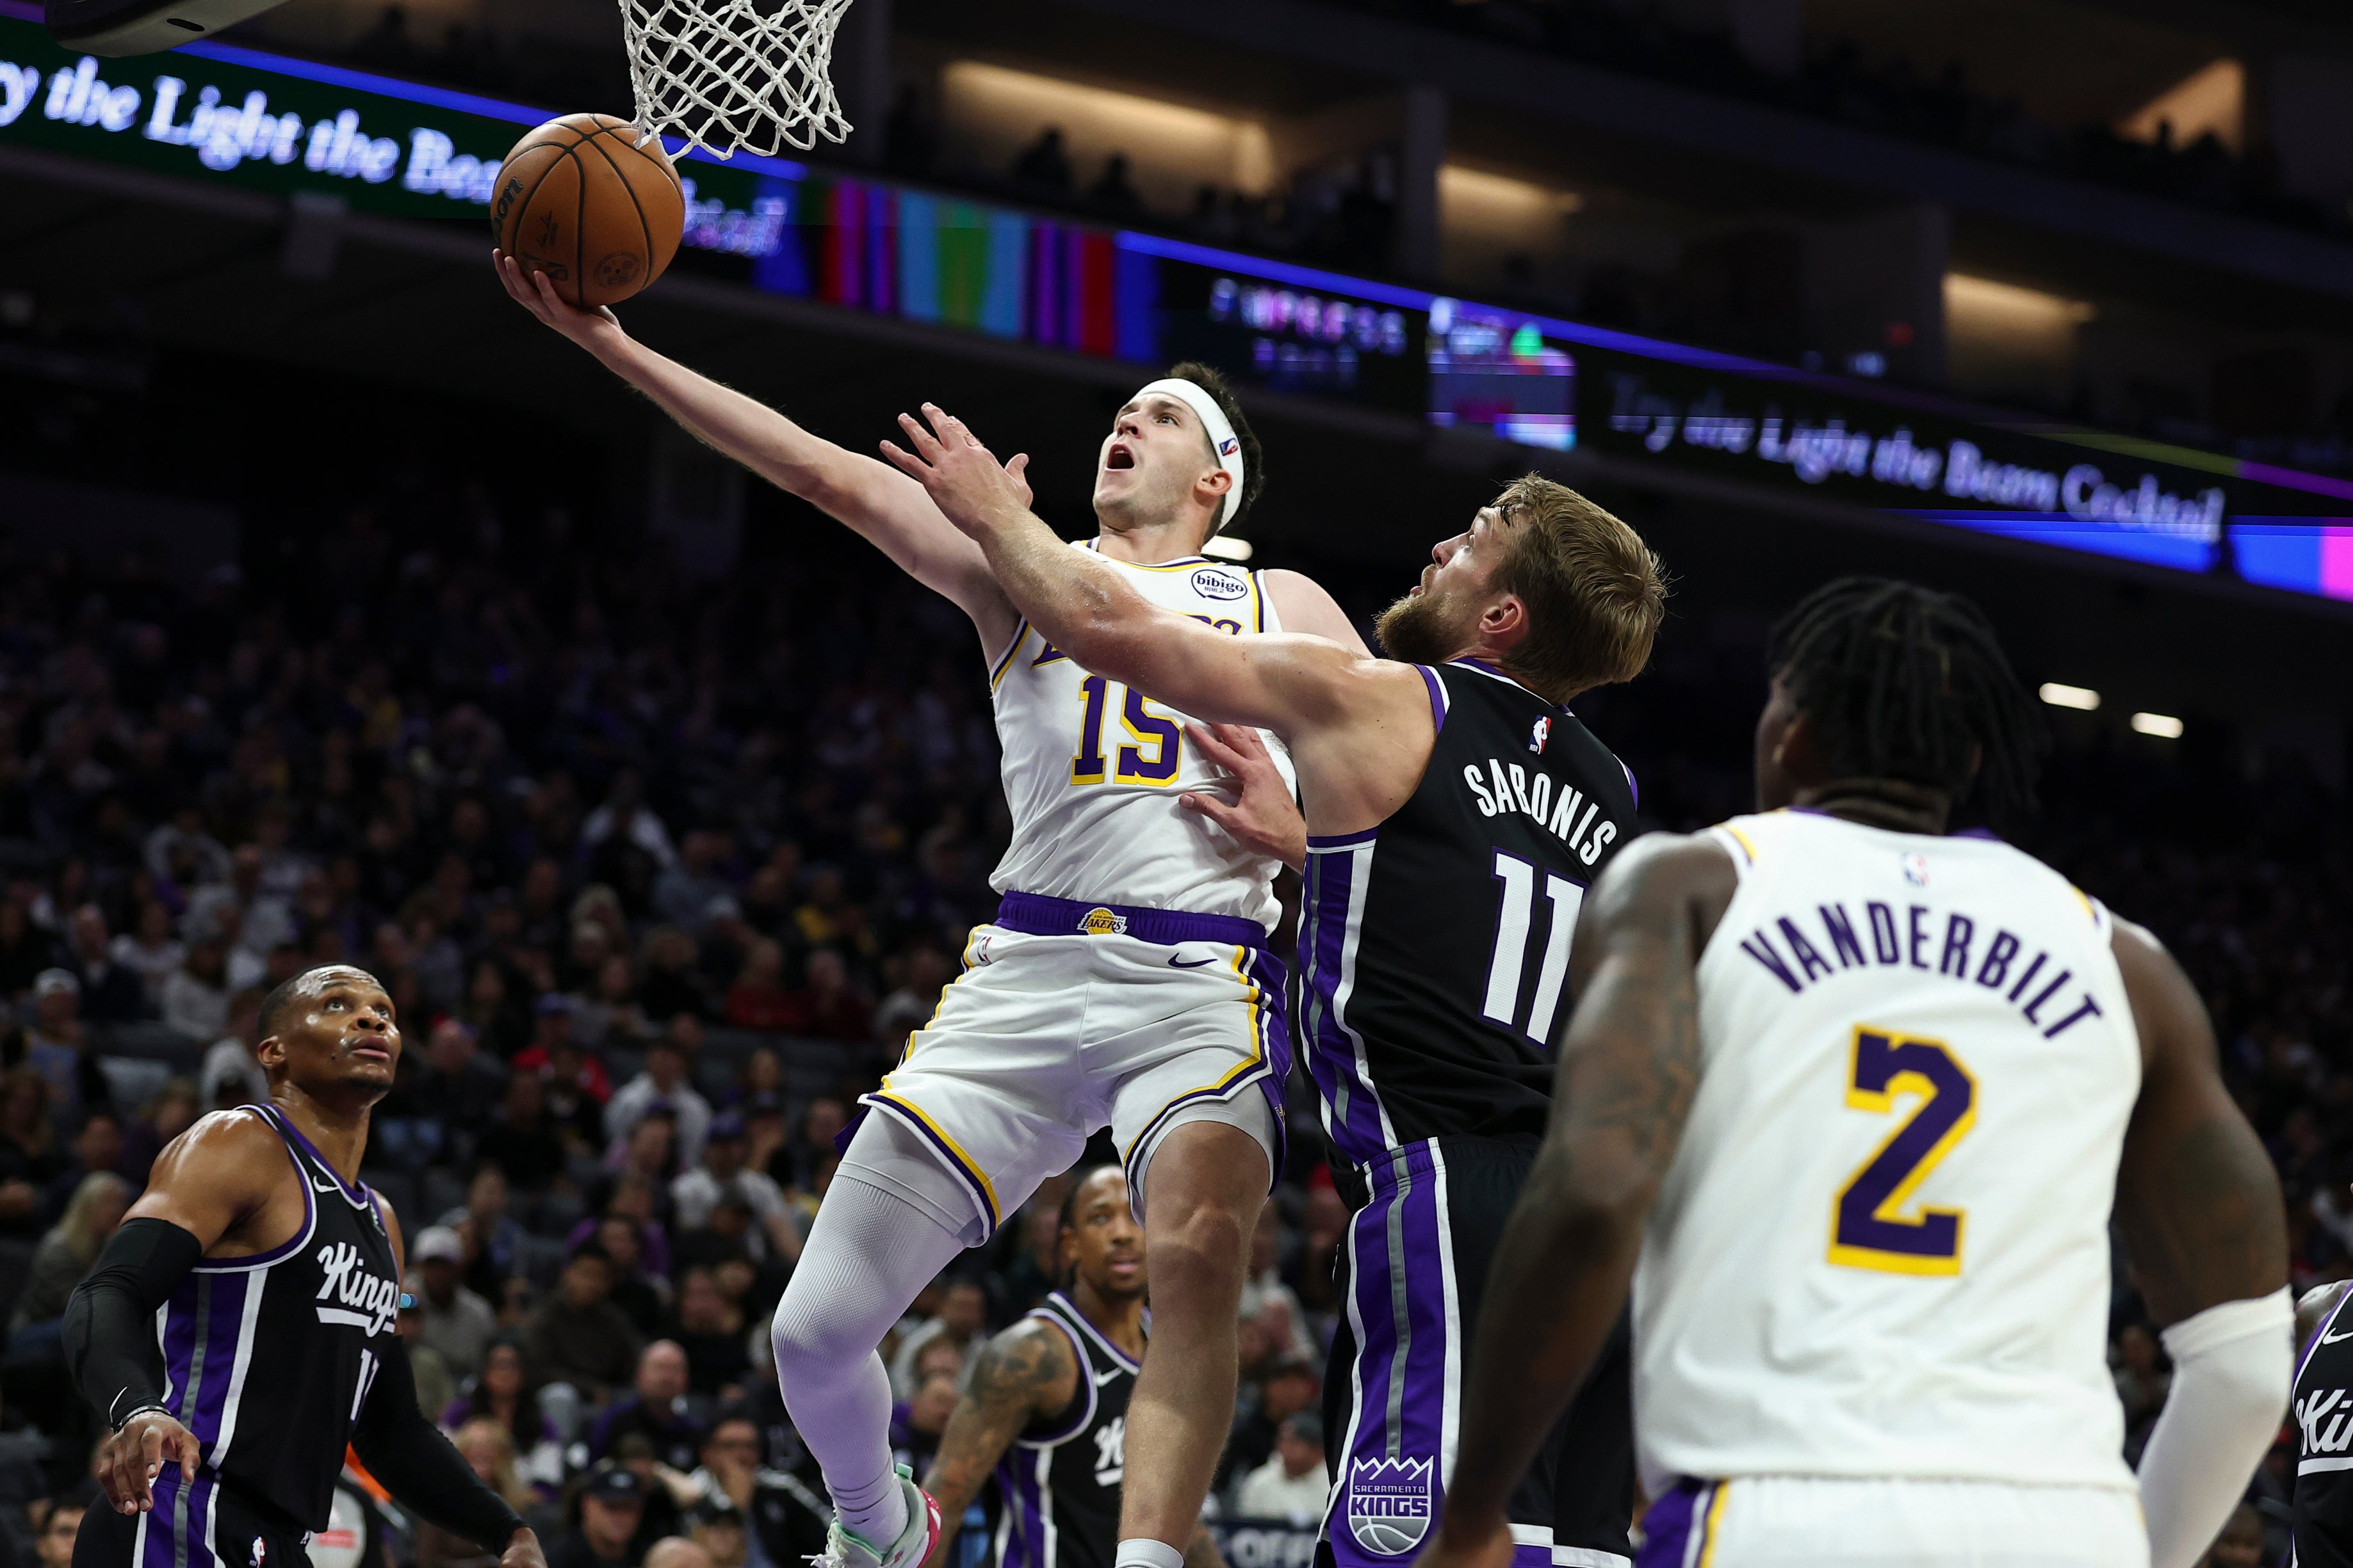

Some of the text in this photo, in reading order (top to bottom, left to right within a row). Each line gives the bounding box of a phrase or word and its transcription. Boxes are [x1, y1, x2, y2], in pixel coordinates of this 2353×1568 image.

[45, 55, 142, 132] the
[143, 76, 304, 171] Light
[305, 108, 400, 184] the
[402, 127, 505, 204] Bea
[1683, 389, 1755, 454] the
[1757, 405, 1871, 484] Light
[1871, 426, 1944, 490] the
[1943, 439, 2059, 512] Beam
[2061, 464, 2226, 543] Cocktail
[1196, 574, 1244, 592] bibigo
[1071, 674, 1184, 787] 15
[1463, 758, 1617, 866] SABONIS
[1080, 914, 1125, 934] LAKERS
[1480, 848, 1588, 1048] 11
[1739, 900, 2104, 1040] VANDERBILT
[1826, 1022, 1980, 1276] 2
[350, 1348, 379, 1421] 1
[2296, 1389, 2353, 1457] Ki
[1351, 1497, 1428, 1517] KINGS
[1355, 1485, 1425, 1493] SACRAMENTO
